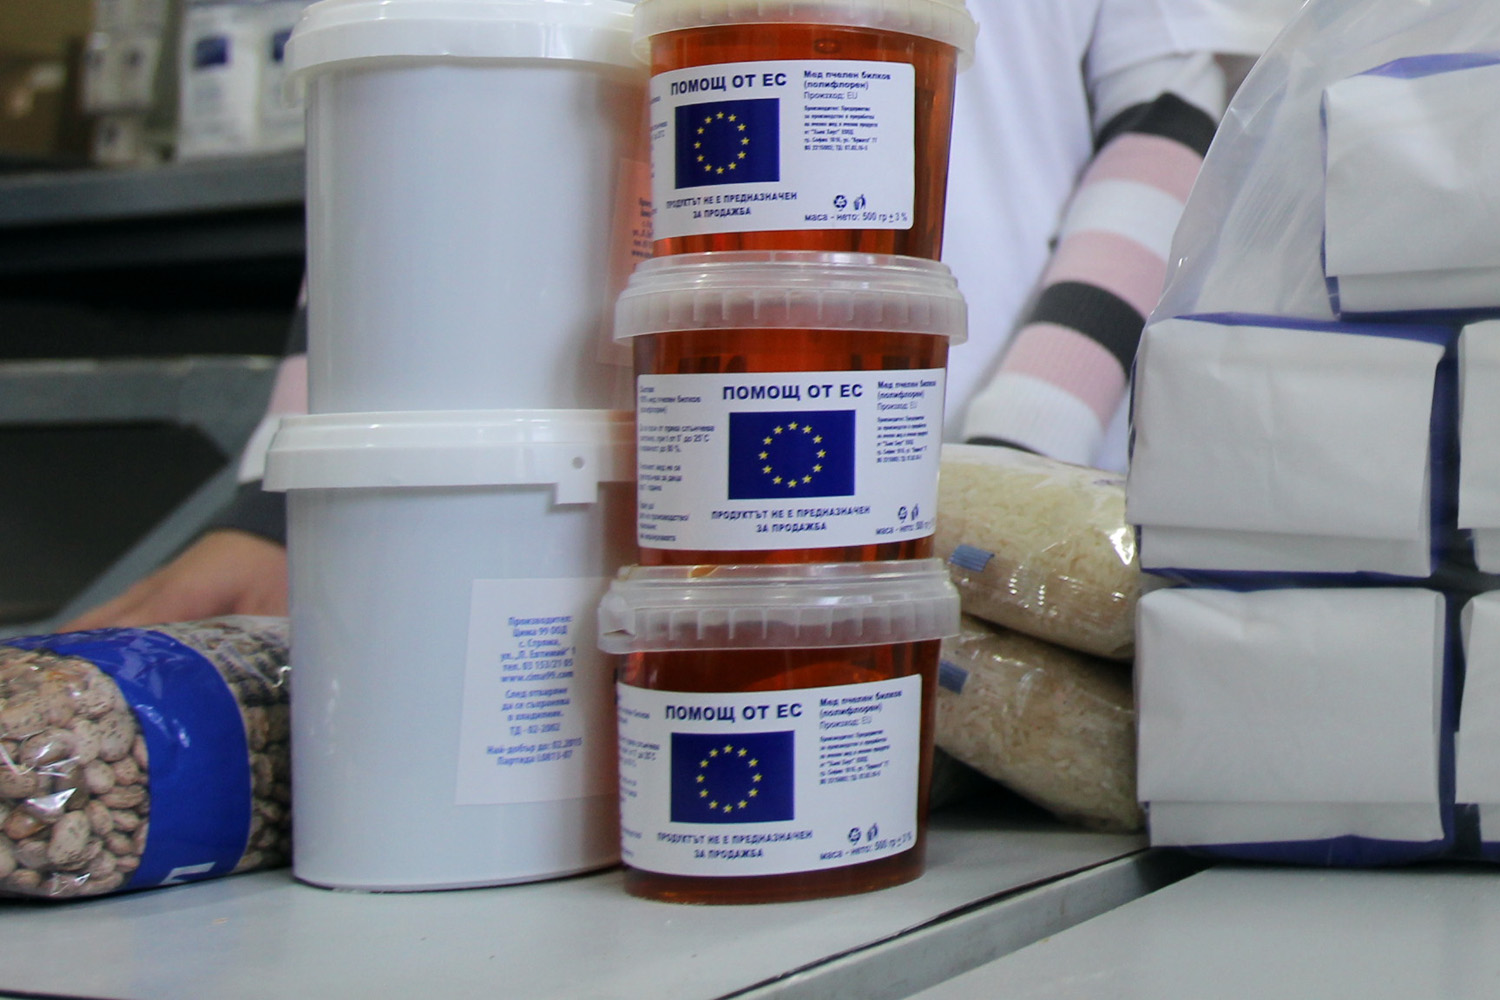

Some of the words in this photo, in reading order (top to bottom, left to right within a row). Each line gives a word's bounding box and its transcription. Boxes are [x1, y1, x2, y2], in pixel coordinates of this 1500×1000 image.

[804, 70, 823, 79] Мед
[826, 71, 859, 79] пчелен
[671, 76, 726, 96] ПОМОЩ
[732, 73, 756, 89] ОТ
[763, 72, 787, 87] ЕС
[666, 197, 702, 209] ПРОДУКТЪТ
[703, 195, 714, 205] НЕ
[716, 195, 721, 203] Е
[723, 191, 797, 204] ПРЕДНАЗНАЧЕН
[693, 210, 702, 219] ЗА
[703, 207, 752, 219] ПРОДАЖБА
[804, 213, 828, 222] маса
[722, 385, 801, 401] ПОМОЩ
[808, 384, 833, 398] ОТ
[839, 383, 863, 398] ЕС
[711, 509, 767, 520] ПРОДУКТЪТ
[772, 509, 784, 518] НЕ
[787, 509, 793, 517] Е
[797, 506, 871, 518] ПРЕДНАЗНАЧЕН
[756, 524, 769, 533] ЗА
[772, 522, 827, 533] ПРОДАЖБА
[665, 704, 736, 723] ПОМОЩ
[742, 704, 770, 720] ОТ
[777, 702, 804, 718] ЕС
[657, 831, 704, 844] ПРОДУКТЪТ
[708, 834, 720, 844] НЕ
[723, 834, 728, 843] Е
[732, 830, 813, 844] ПРЕДНАЗНАЧЕН
[694, 849, 705, 858] ЗА
[707, 848, 764, 859] ПРОДАЖБА
